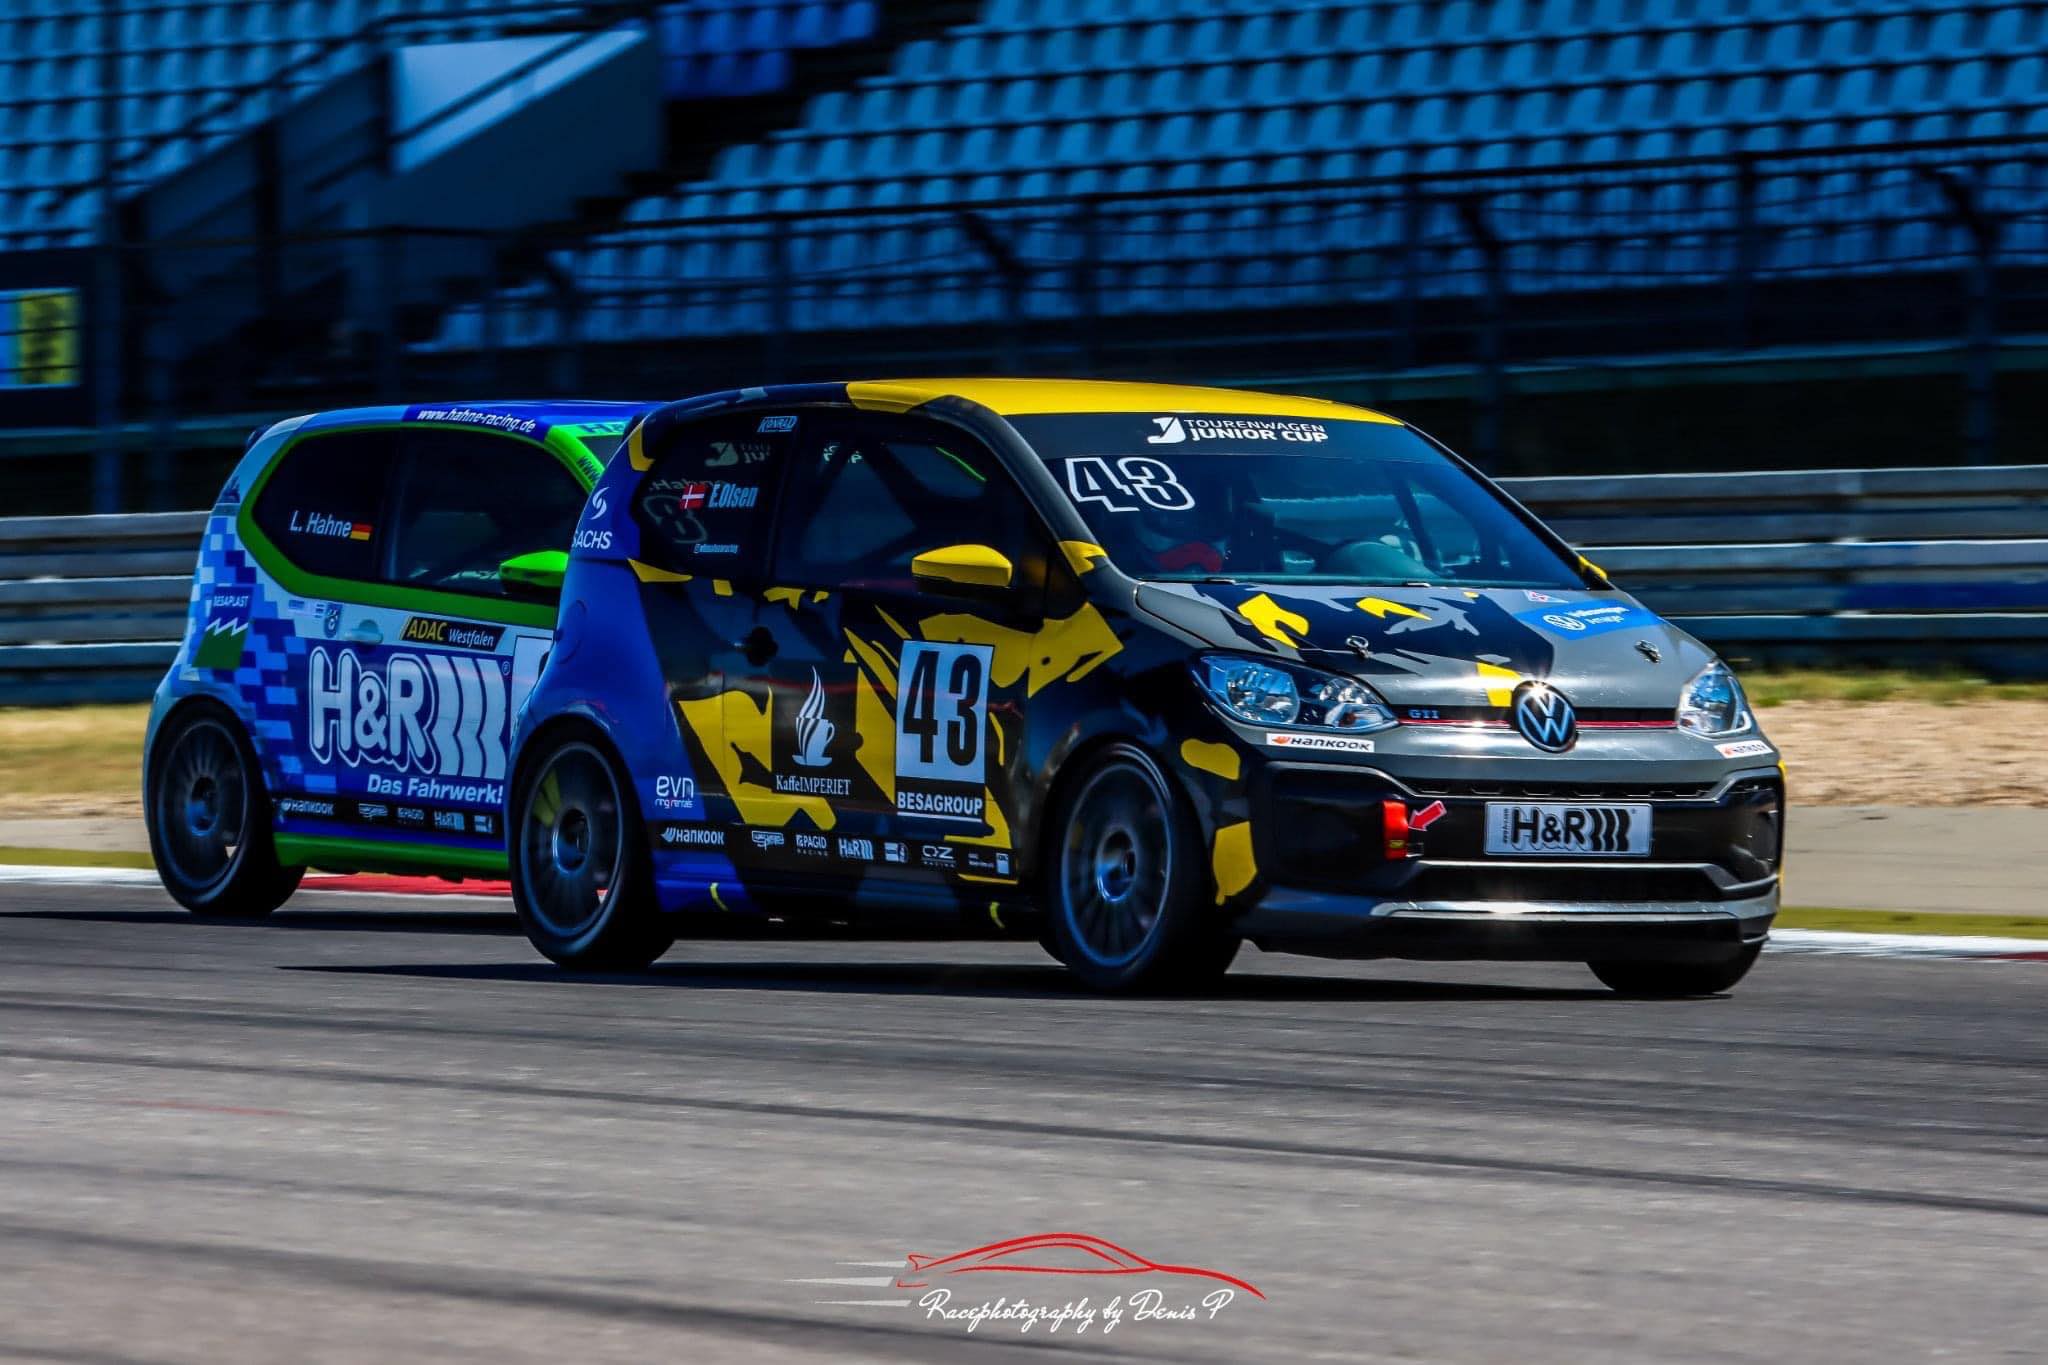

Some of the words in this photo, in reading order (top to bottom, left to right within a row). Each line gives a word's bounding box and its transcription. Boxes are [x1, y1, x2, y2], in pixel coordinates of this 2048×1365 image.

[416, 408, 536, 433] www.hahne-racing.de
[1183, 419, 1326, 433] TOURENWAGEN
[1190, 428, 1278, 441] JUNIOR
[1281, 431, 1329, 442] CUP
[1065, 457, 1196, 512] 43
[306, 512, 352, 538] Hahne
[407, 620, 448, 641] ADAC
[449, 628, 495, 648] Westfalen
[309, 646, 436, 775] H&R
[903, 651, 982, 767] 43
[367, 774, 402, 795] Das
[407, 777, 503, 804] Fahrwerk!
[656, 775, 695, 799] evn
[897, 791, 983, 816] BESAGROUP
[1512, 806, 1590, 851] H&R
[804, 835, 827, 849] PAGID
